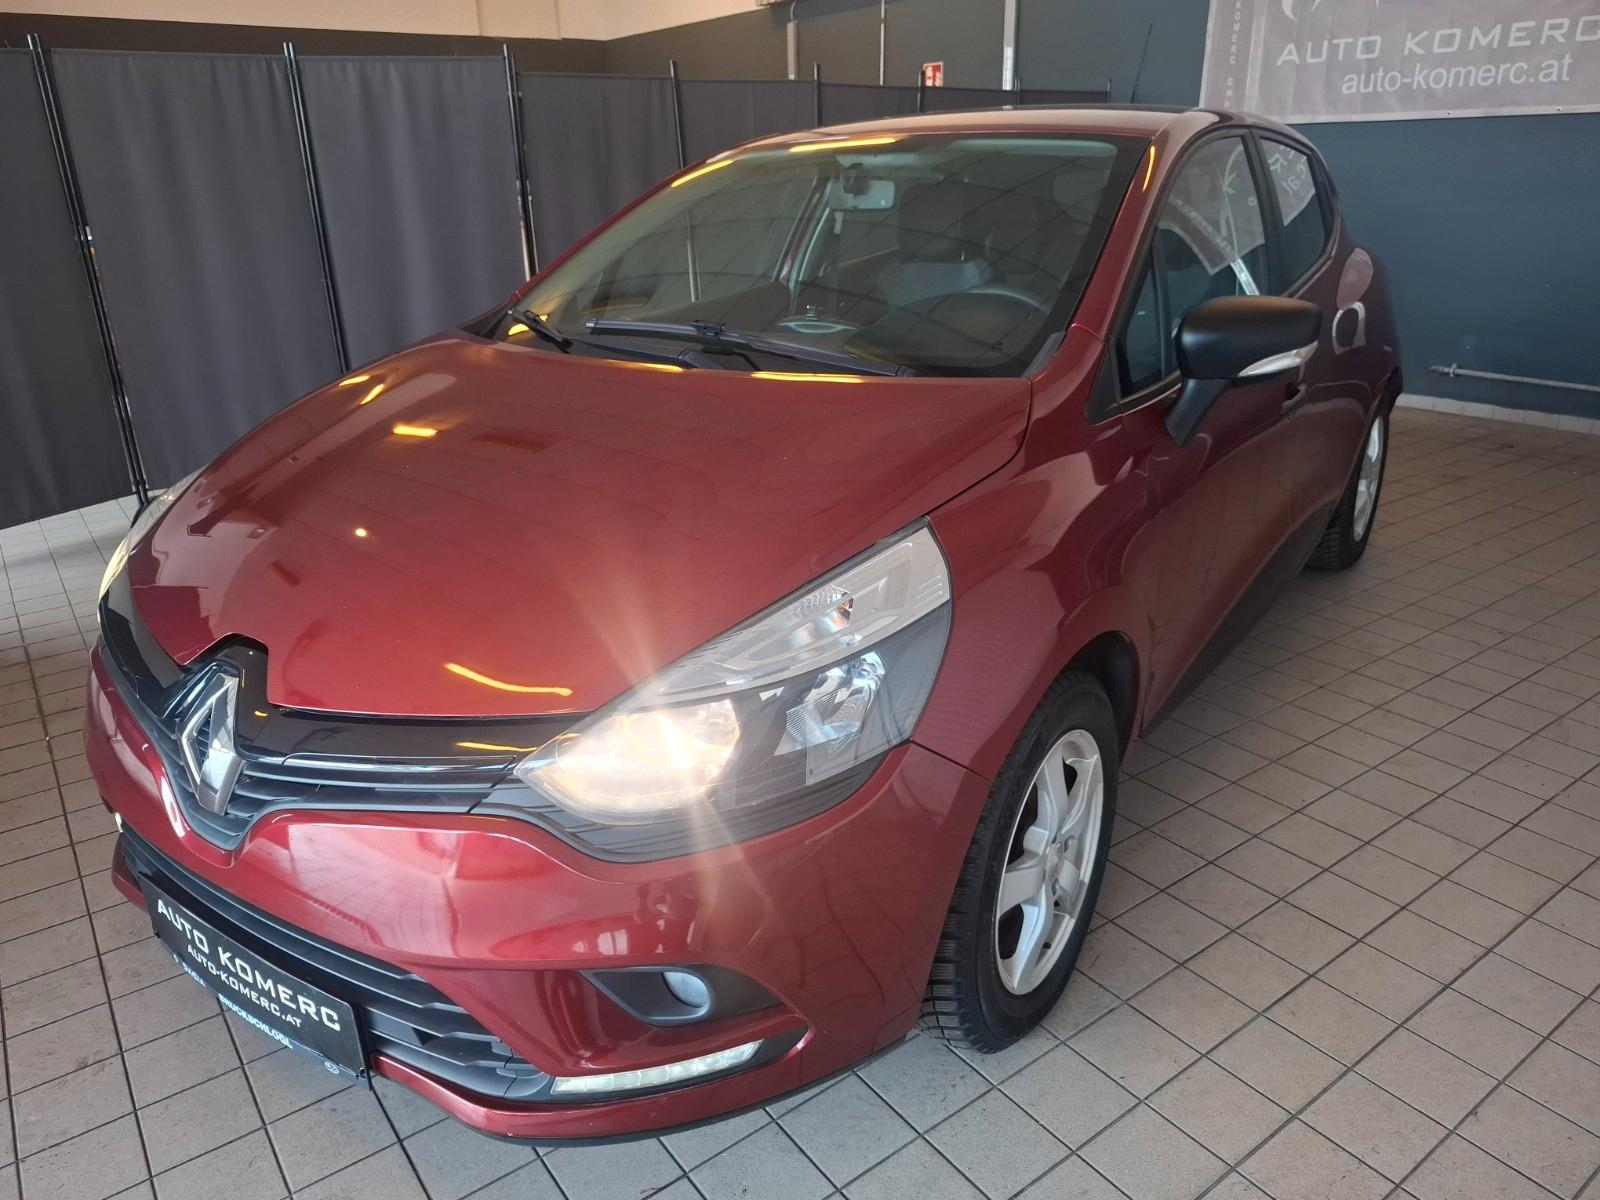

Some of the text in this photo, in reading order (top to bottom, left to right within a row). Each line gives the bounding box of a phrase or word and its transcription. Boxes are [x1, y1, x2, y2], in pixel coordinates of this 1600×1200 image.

[1275, 14, 1600, 66] AUTO KOMERC
[1341, 51, 1573, 95] auto-komerc.at
[157, 898, 209, 955] AUTO
[217, 946, 341, 1032] KOMERC
[187, 943, 303, 1028] AUTO-KOMERC.AT
